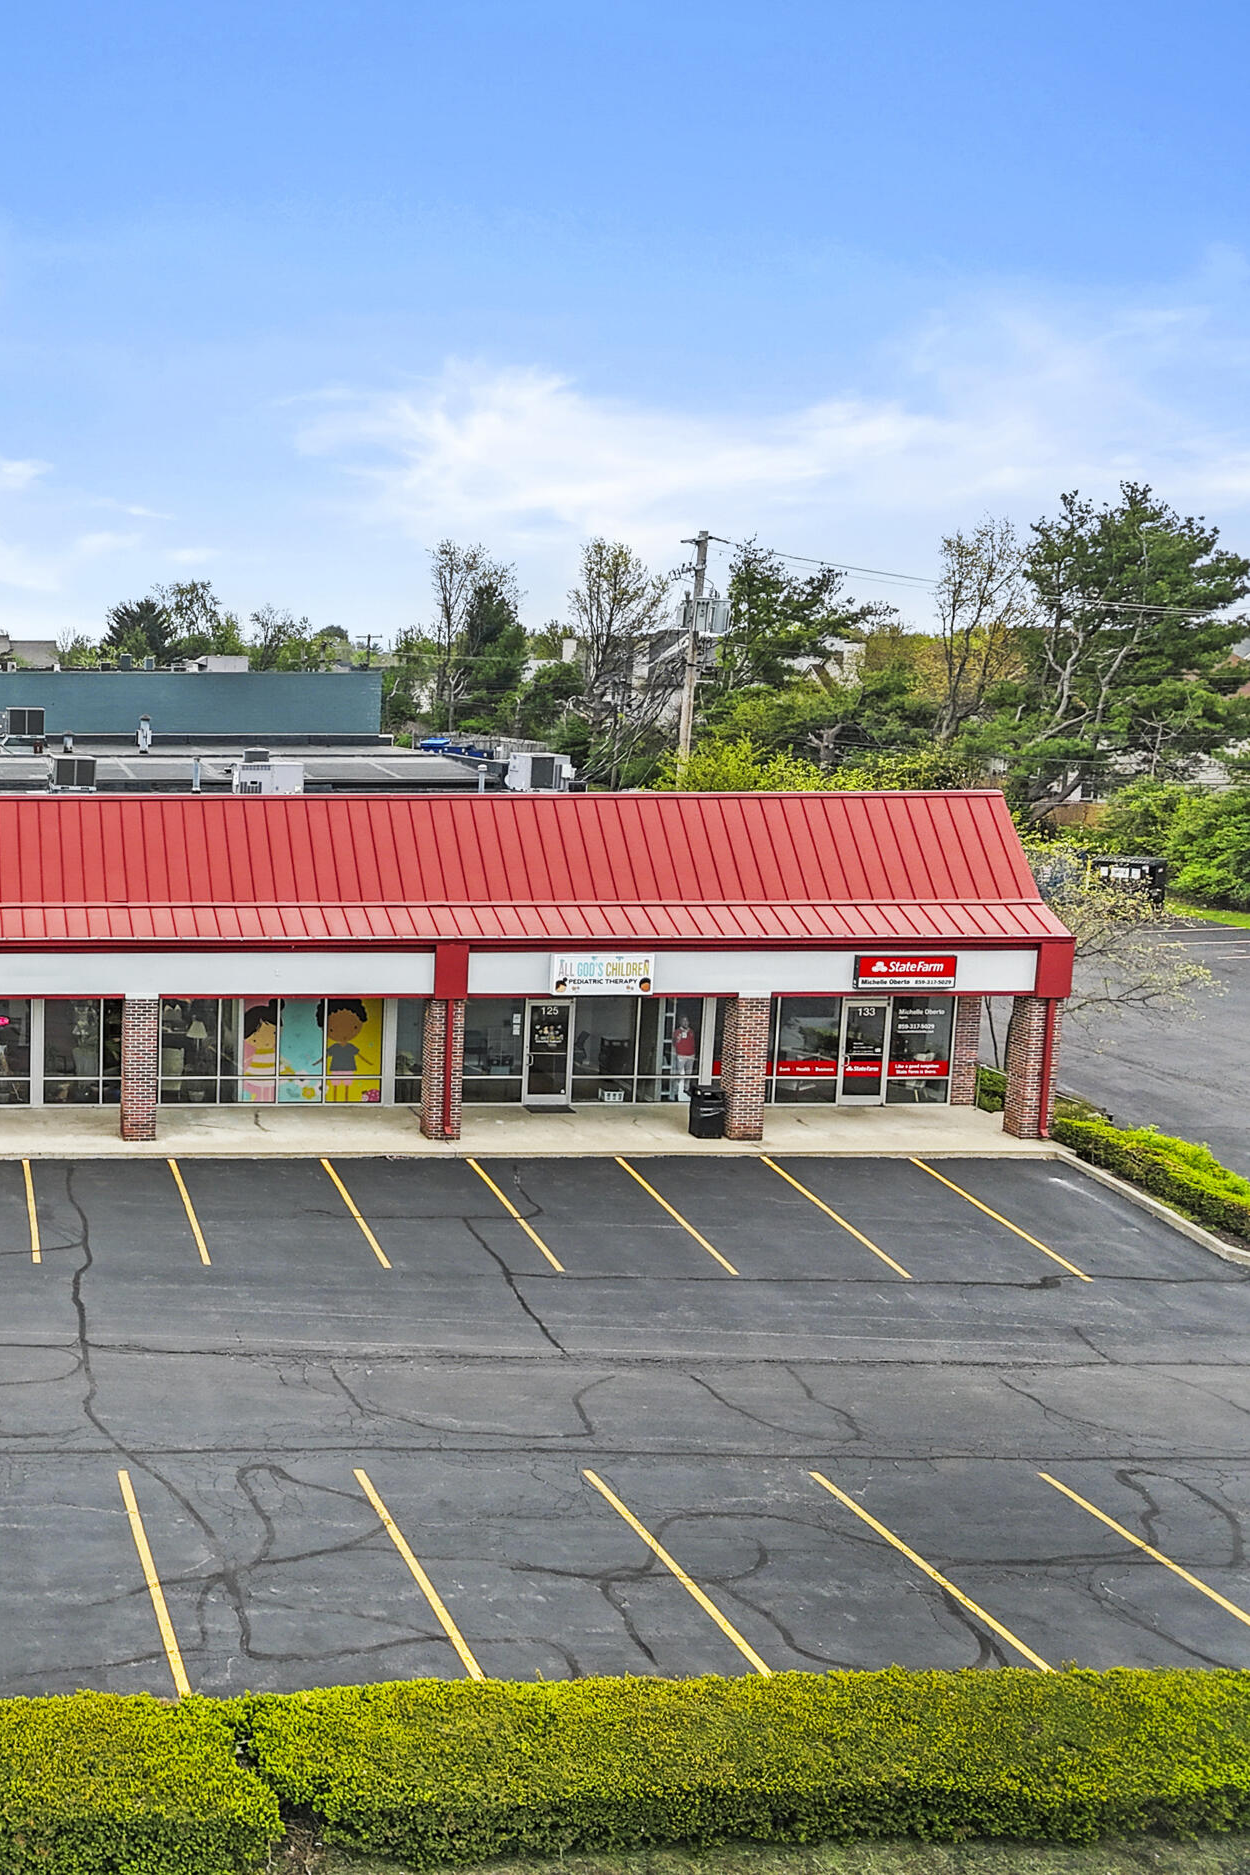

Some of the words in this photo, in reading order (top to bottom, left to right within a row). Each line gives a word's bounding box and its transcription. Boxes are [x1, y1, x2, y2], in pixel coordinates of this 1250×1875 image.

[558, 961, 574, 976] ALL
[577, 962, 604, 977] GOD'S
[606, 961, 650, 977] CHILDREN
[541, 1006, 559, 1016] 125
[857, 1007, 876, 1017] 133
